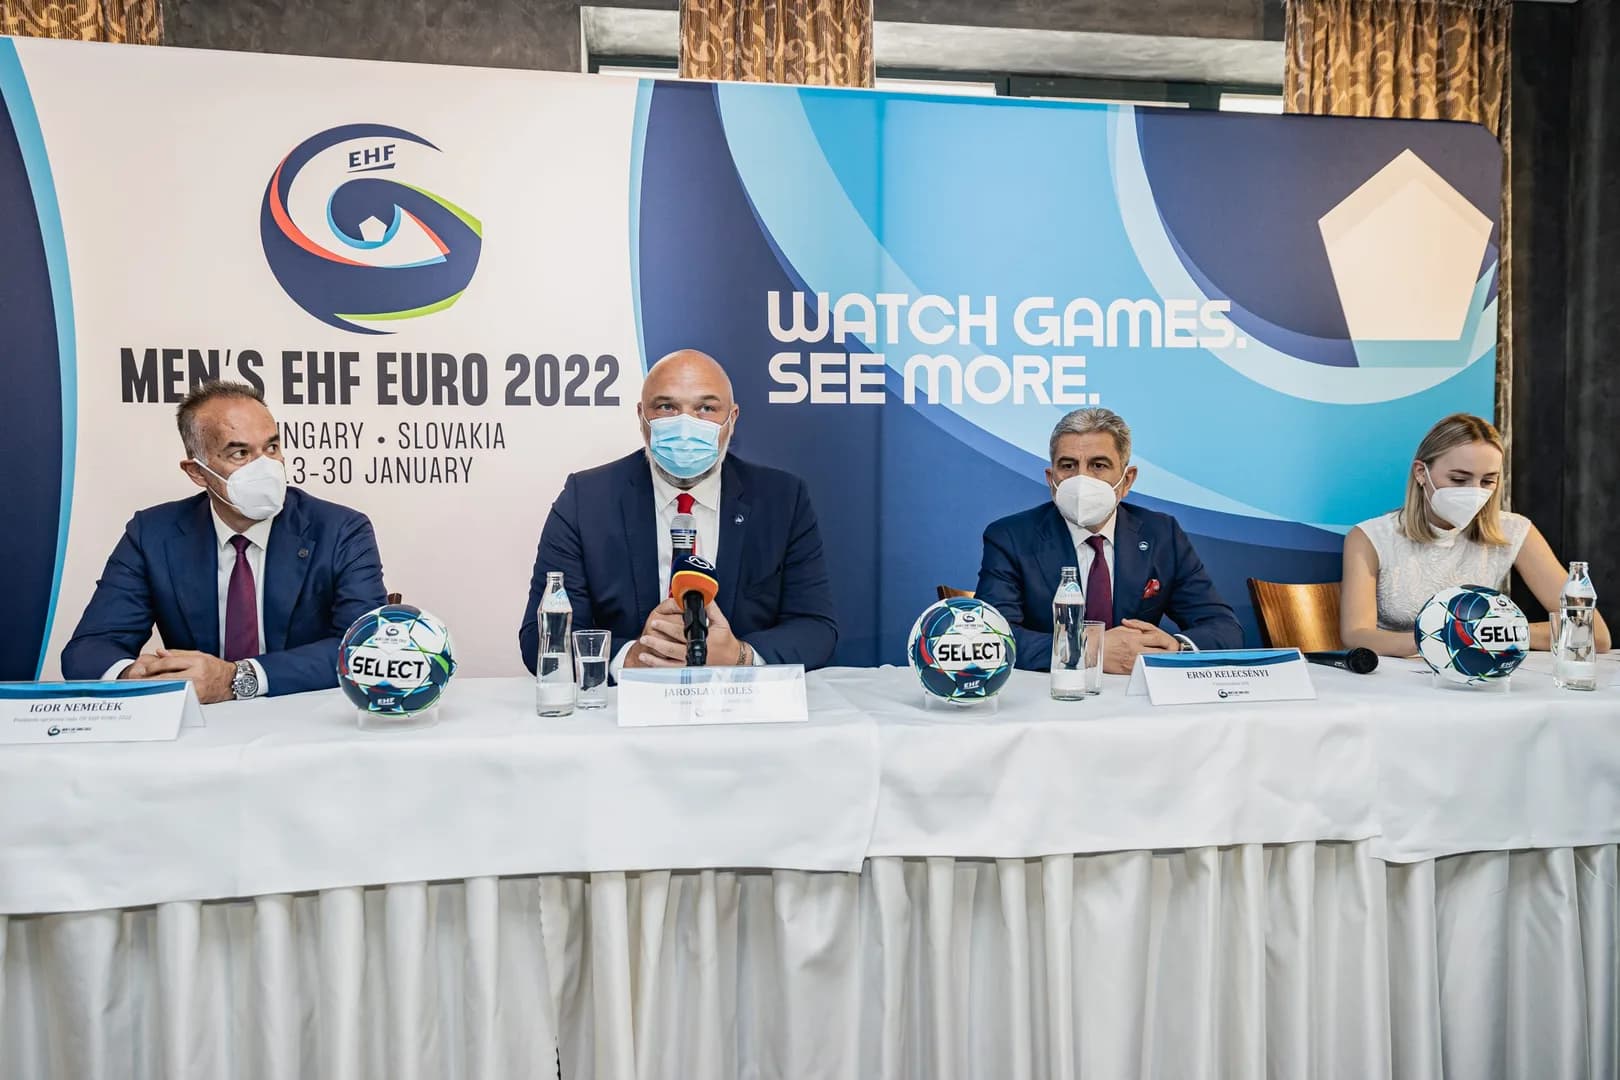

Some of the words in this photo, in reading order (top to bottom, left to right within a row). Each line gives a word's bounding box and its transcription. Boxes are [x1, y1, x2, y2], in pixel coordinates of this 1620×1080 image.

[349, 144, 396, 168] EHF
[767, 291, 997, 346] WATCH
[1013, 296, 1248, 349] GAMES.
[120, 347, 265, 404] MEN'S
[281, 350, 361, 405] EHF
[376, 351, 489, 406] EURO
[504, 353, 621, 407] 2022
[768, 352, 886, 404] SEE
[903, 353, 1100, 405] MORE.
[276, 421, 364, 449] NGARY
[398, 421, 506, 449] SLOVAKIA
[286, 456, 353, 485] 3-30
[365, 456, 474, 484] JANUARY
[938, 642, 1001, 662] SELECT
[352, 656, 425, 679] SELECT
[963, 680, 980, 689] EHF
[30, 703, 61, 713] IGOR
[377, 697, 396, 705] EHF
